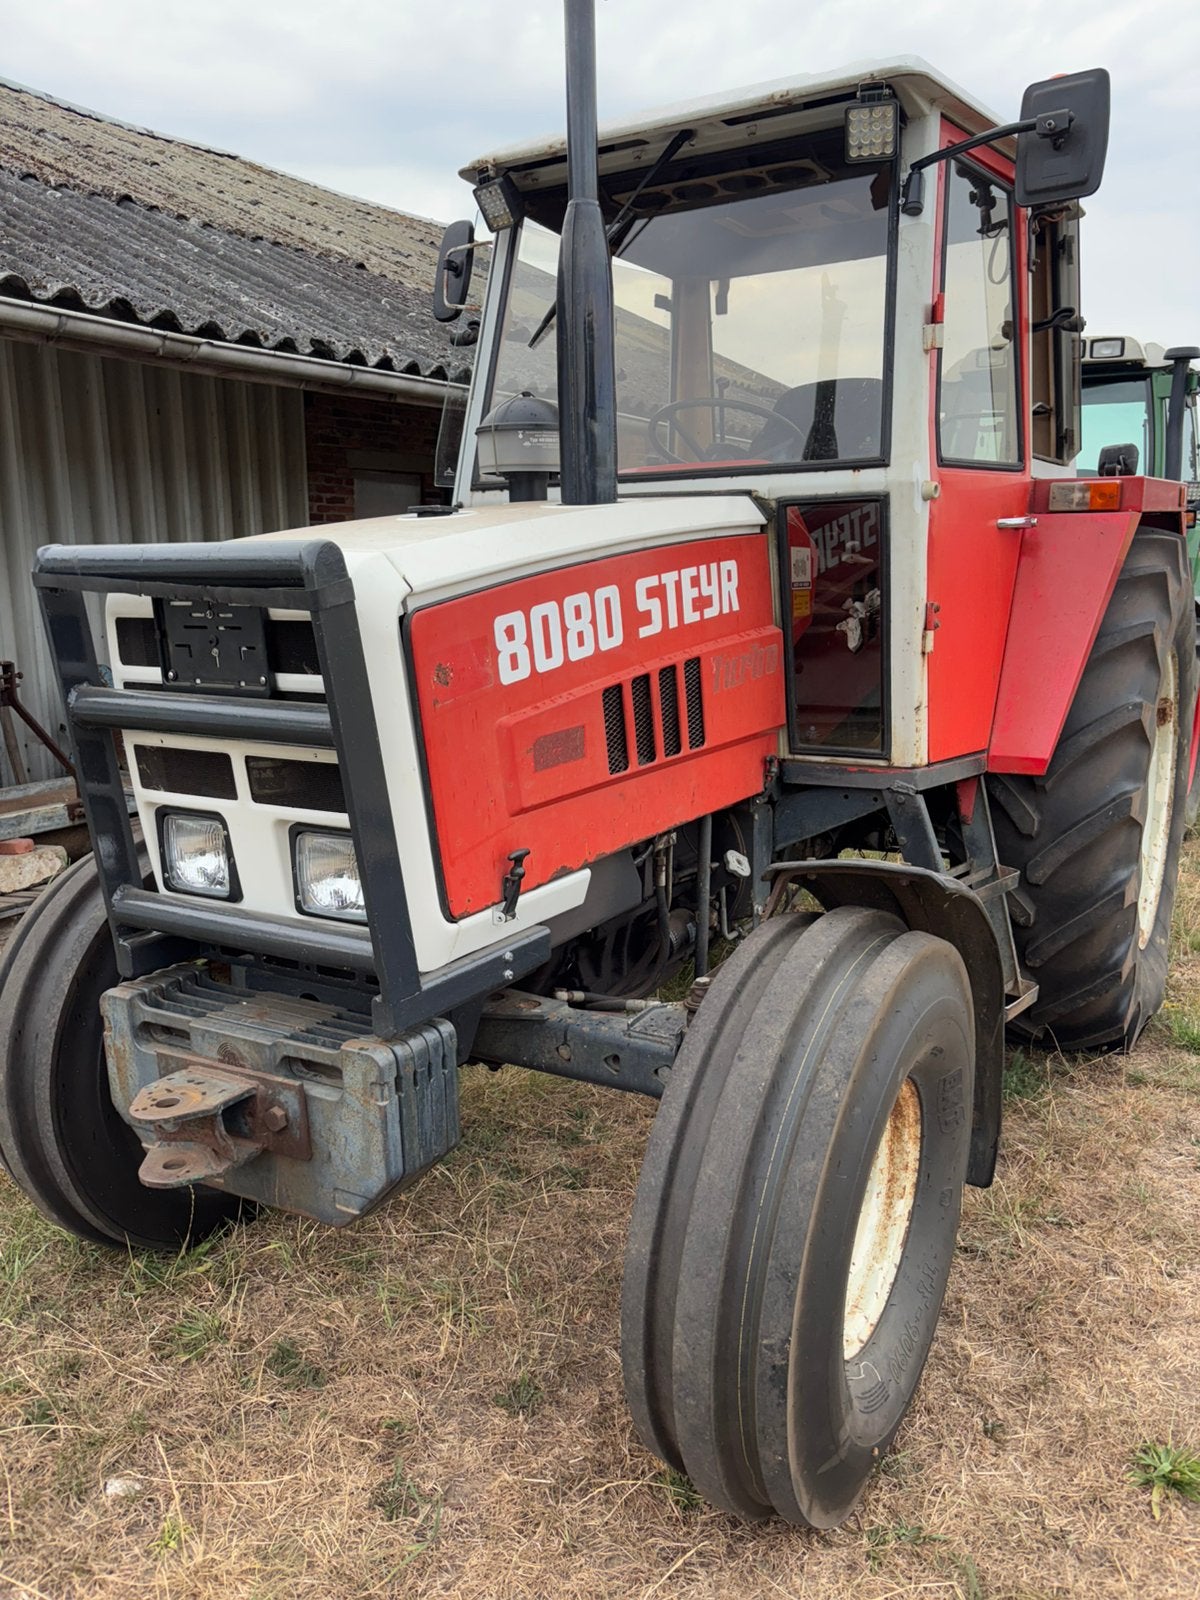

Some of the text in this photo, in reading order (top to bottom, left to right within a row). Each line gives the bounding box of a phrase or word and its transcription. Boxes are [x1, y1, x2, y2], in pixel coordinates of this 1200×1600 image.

[494, 559, 740, 686] 8080 STEYR
[711, 643, 778, 694] Turbo
